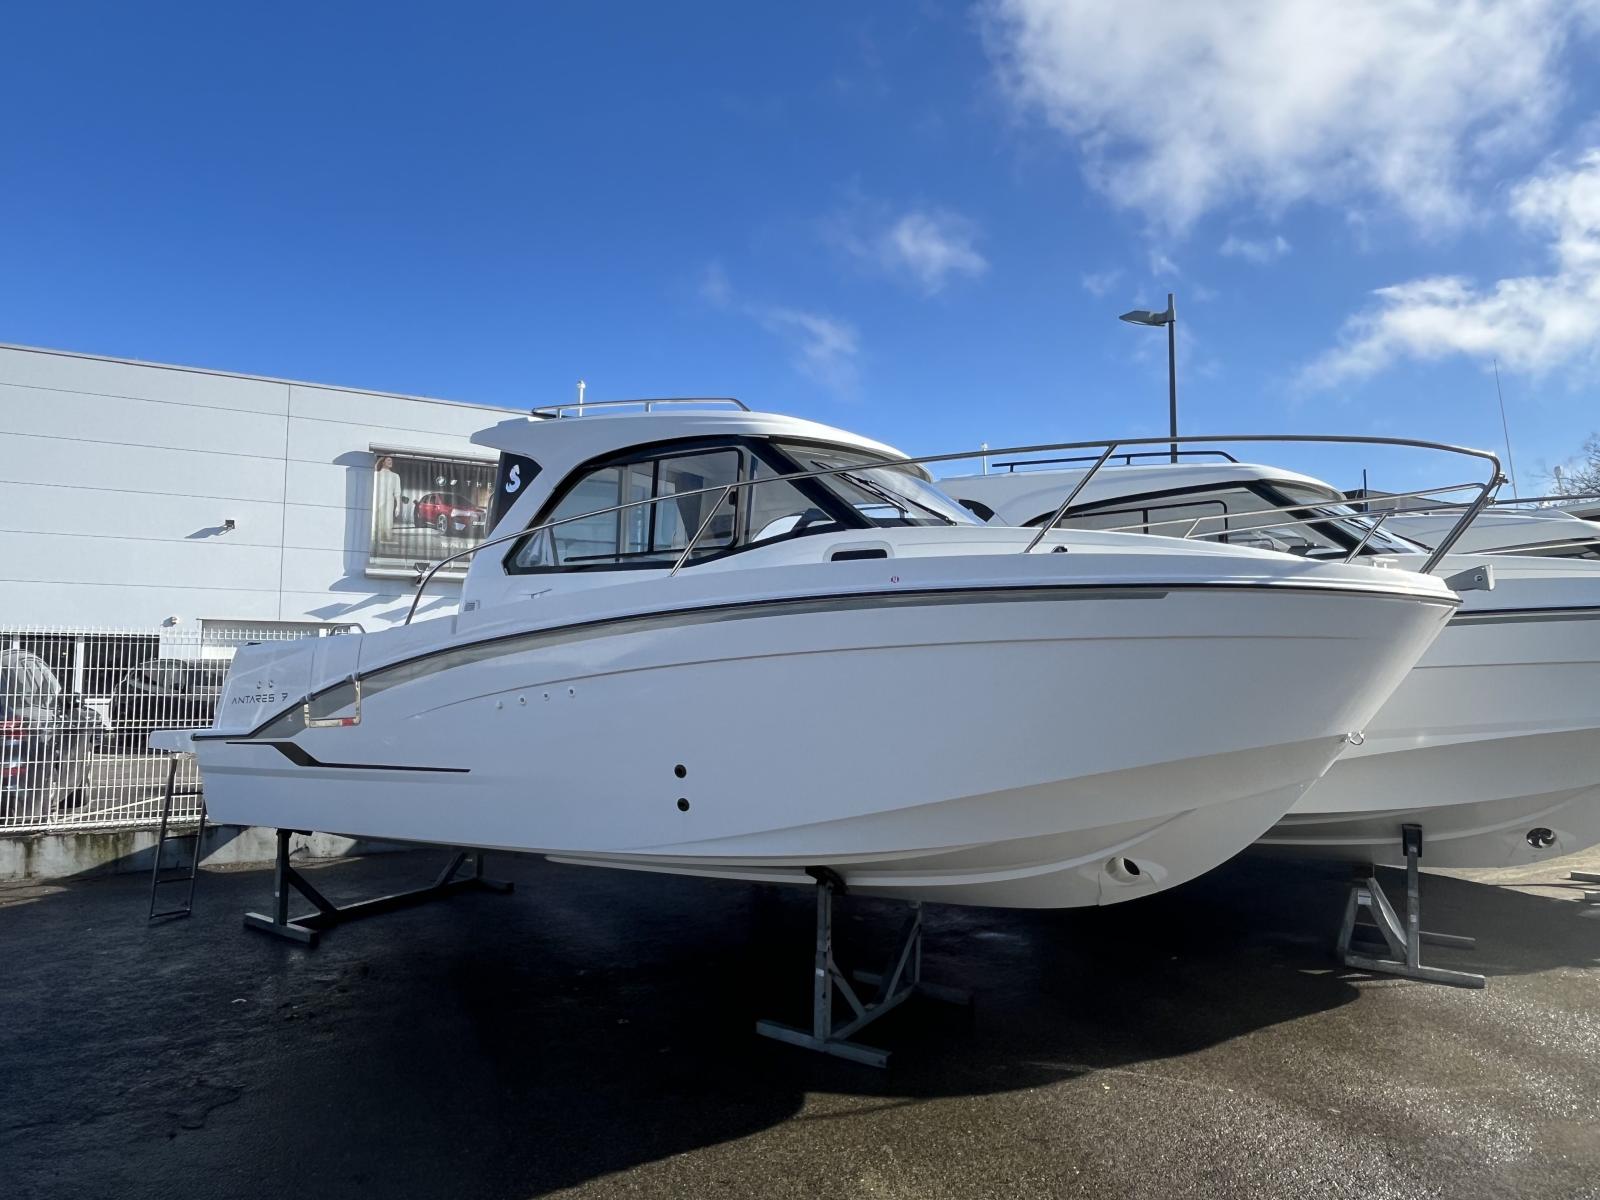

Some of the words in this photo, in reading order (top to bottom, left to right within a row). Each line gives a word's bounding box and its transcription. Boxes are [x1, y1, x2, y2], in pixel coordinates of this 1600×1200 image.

[466, 480, 492, 488] THE
[231, 693, 275, 704] ANTARES
[281, 692, 288, 701] 7
